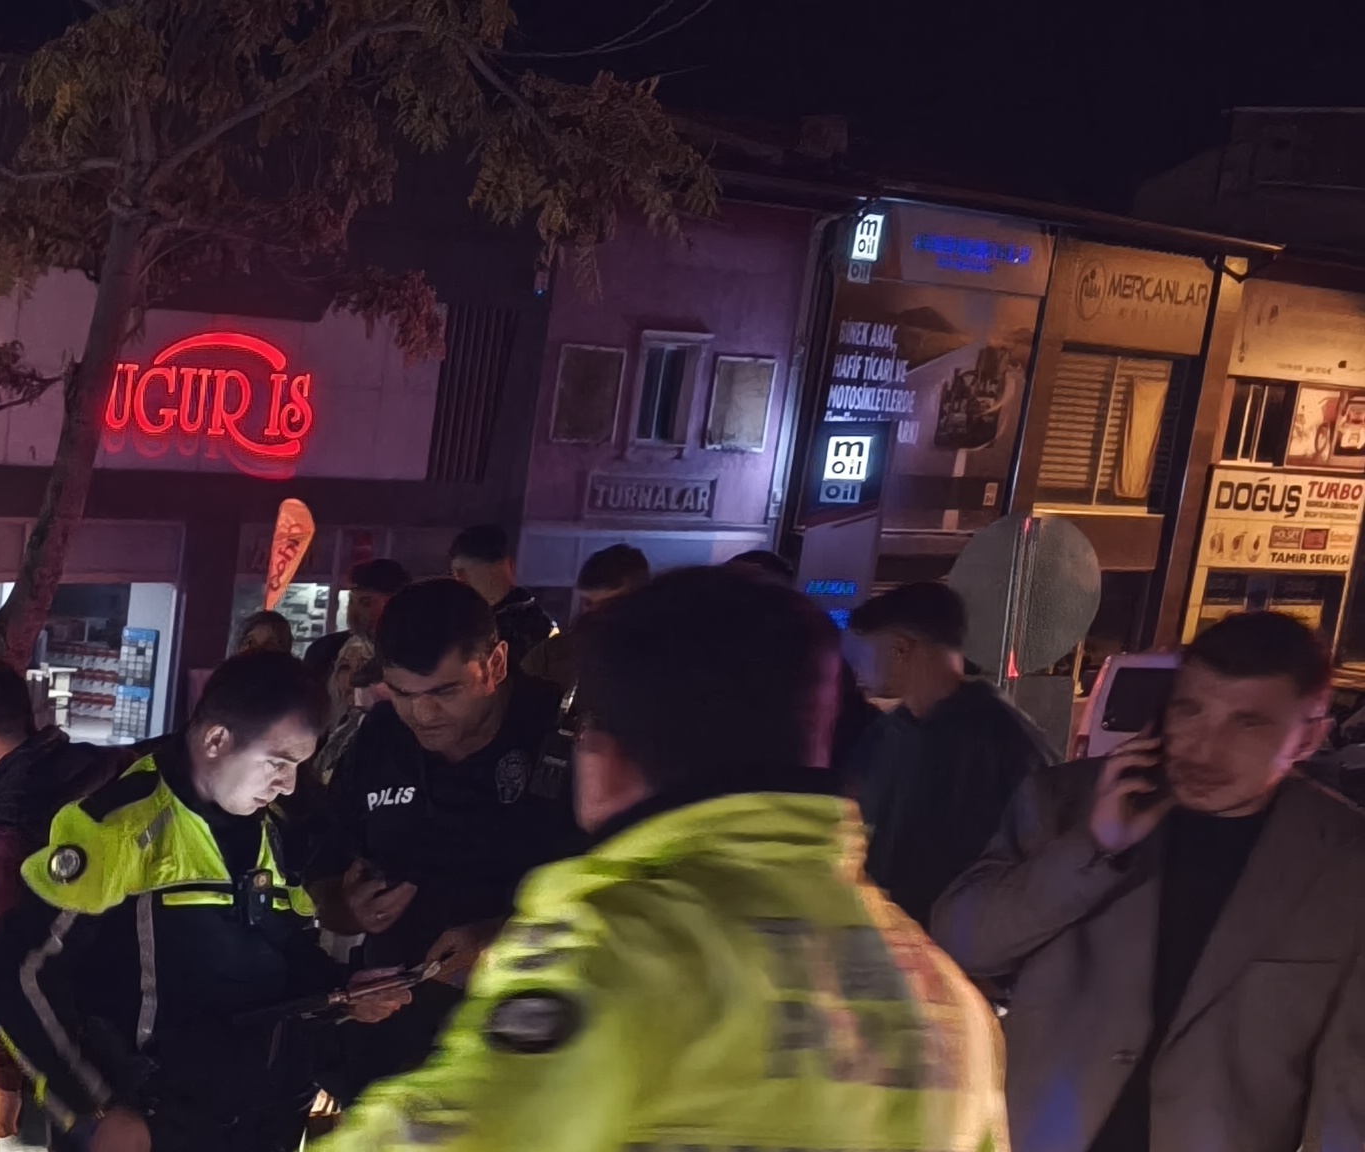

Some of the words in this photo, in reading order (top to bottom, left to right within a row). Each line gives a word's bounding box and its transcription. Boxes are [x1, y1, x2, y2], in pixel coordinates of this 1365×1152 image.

[1107, 272, 1209, 307] MERCANLAR
[1214, 476, 1303, 519] DOĞUŞ
[1307, 480, 1364, 501] TURBO
